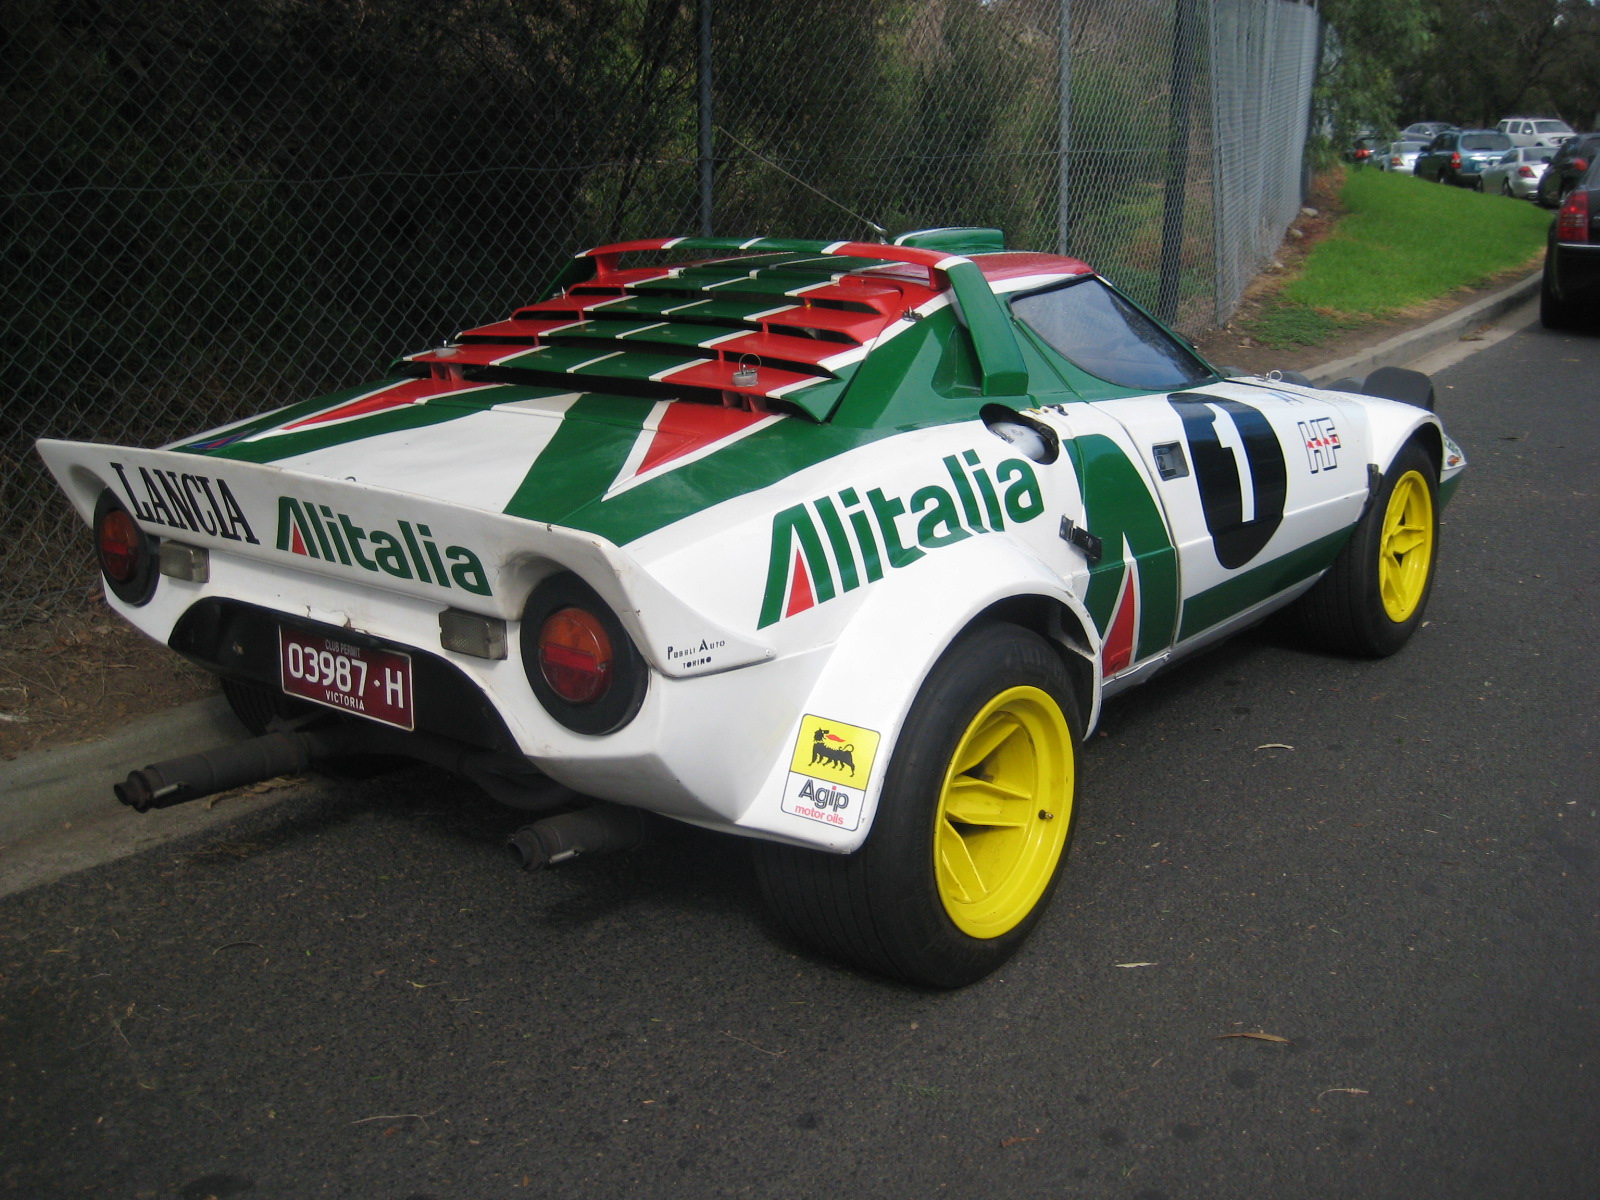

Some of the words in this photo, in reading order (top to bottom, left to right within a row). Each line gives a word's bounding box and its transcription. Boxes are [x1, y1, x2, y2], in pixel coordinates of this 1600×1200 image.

[1203, 402, 1255, 523] 1
[1297, 416, 1341, 474] HF
[109, 462, 260, 545] LANCIA
[276, 495, 493, 597] Alitalia
[756, 449, 1045, 631] Alitalia
[325, 639, 341, 652] CLUB
[340, 641, 361, 658] PERMIT
[682, 656, 712, 669] TORINO
[325, 689, 365, 711] VICTORIA
[795, 805, 825, 820] motor
[826, 813, 844, 825] oils
[798, 778, 849, 813] Agip
